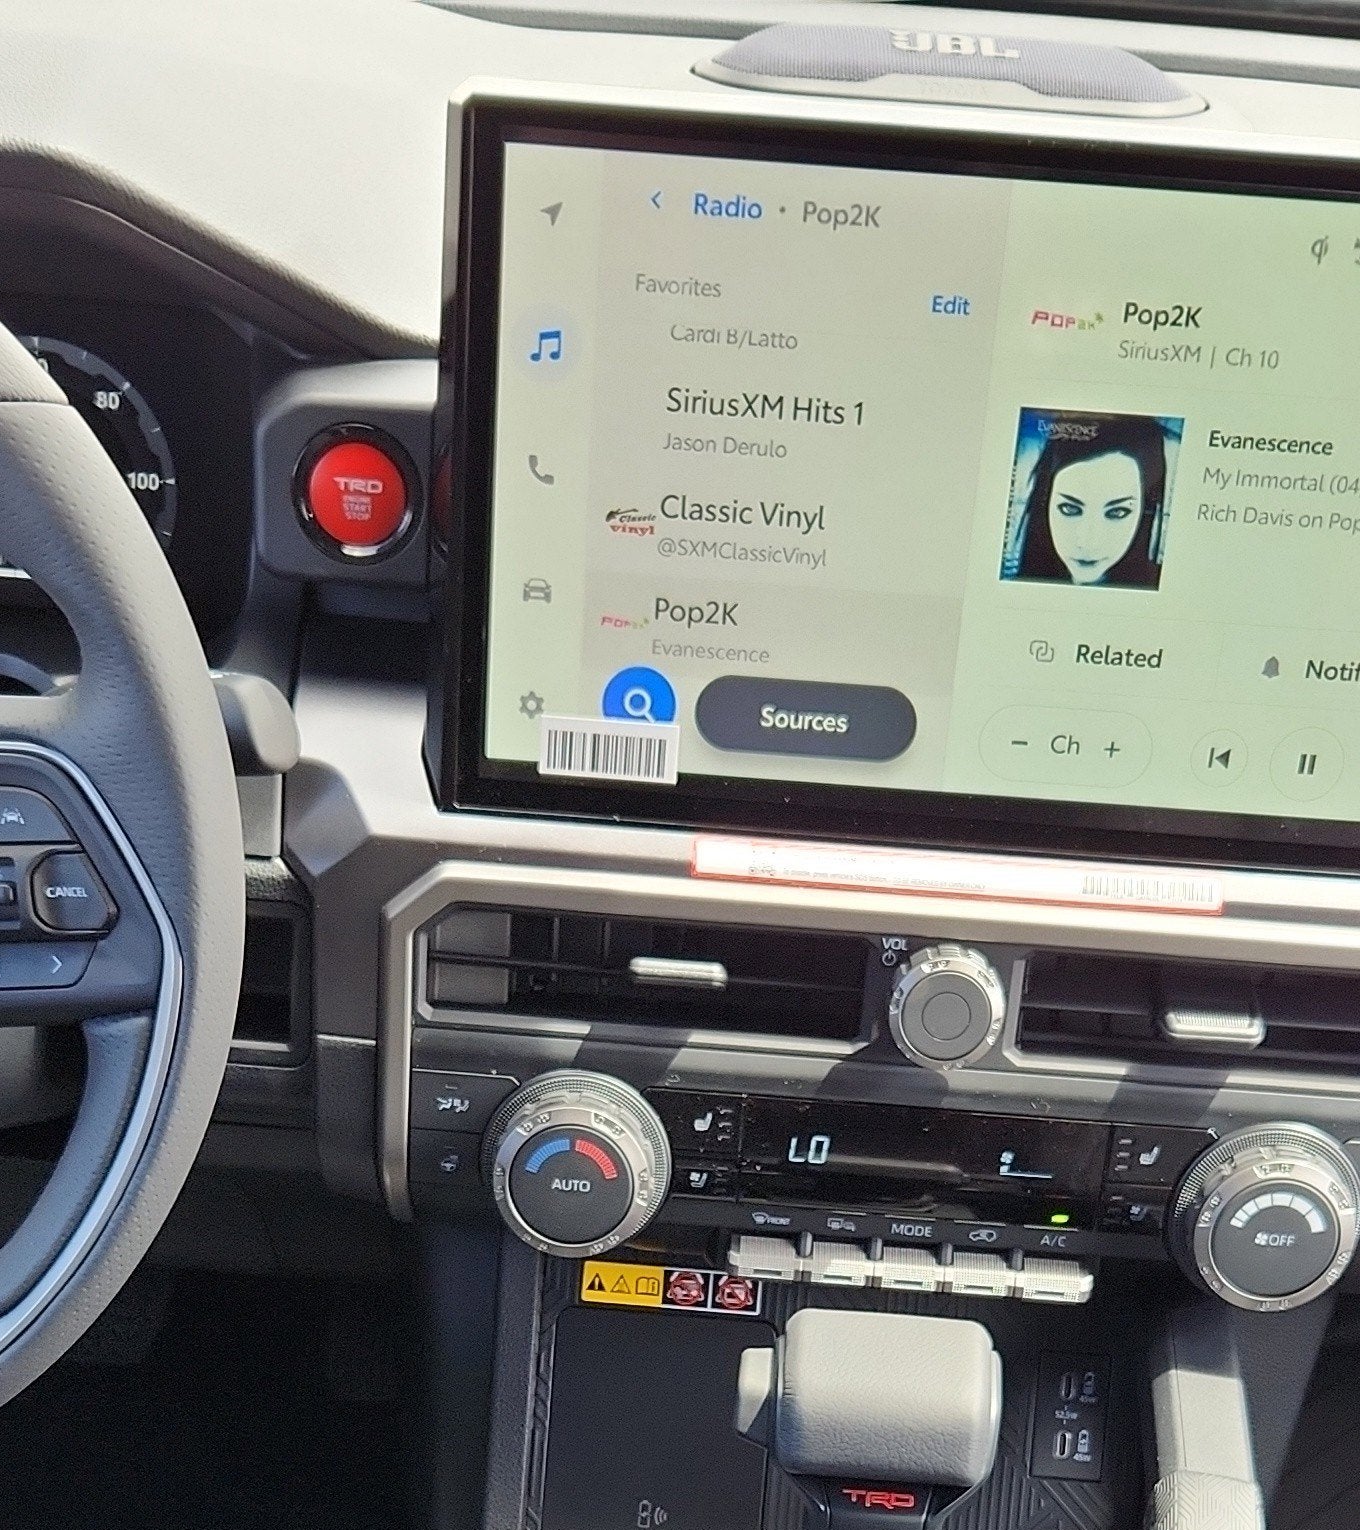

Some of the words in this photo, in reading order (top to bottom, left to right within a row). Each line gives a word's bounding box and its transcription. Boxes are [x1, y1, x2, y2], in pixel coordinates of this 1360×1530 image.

[893, 29, 1019, 59] JBL
[693, 192, 763, 220] Radio
[802, 200, 882, 231] Pop2K
[635, 273, 722, 299] Favorites
[931, 295, 971, 317] Edit
[1123, 302, 1204, 331] Pop2K
[727, 327, 798, 351] B/Latto
[1118, 341, 1202, 364] SiriusXM
[1226, 348, 1252, 368] Ch
[1260, 350, 1280, 370] 10
[92, 390, 120, 410] 80
[667, 387, 784, 422] SiriusXM
[792, 394, 845, 425] Hits
[853, 401, 865, 427] 1
[663, 432, 717, 455] Jason
[723, 435, 787, 459] Derulo
[1209, 430, 1334, 456] Evanescence
[127, 472, 160, 491] 100
[333, 477, 384, 494] TRD
[1203, 467, 1233, 489] My
[1236, 469, 1324, 494] Immortal
[660, 494, 753, 527] Classic
[761, 501, 826, 532] Vinyl
[1197, 504, 1237, 525] Rich
[1243, 507, 1294, 528] Davis
[1298, 513, 1323, 529] on
[657, 537, 827, 568] @SXMClassicVinyl
[653, 597, 739, 628] Pop2K
[651, 639, 771, 664] Evanescence
[1075, 643, 1163, 669] Related
[759, 704, 850, 735] Sources
[1050, 734, 1081, 756] Ch
[46, 886, 88, 899] CANCEL
[882, 937, 907, 950] VOL
[551, 1178, 590, 1192] AUTO
[891, 1223, 933, 1238] MODE
[1040, 1233, 1066, 1249] A/C
[1268, 1235, 1295, 1247] OFF
[842, 1488, 916, 1510] TRD
